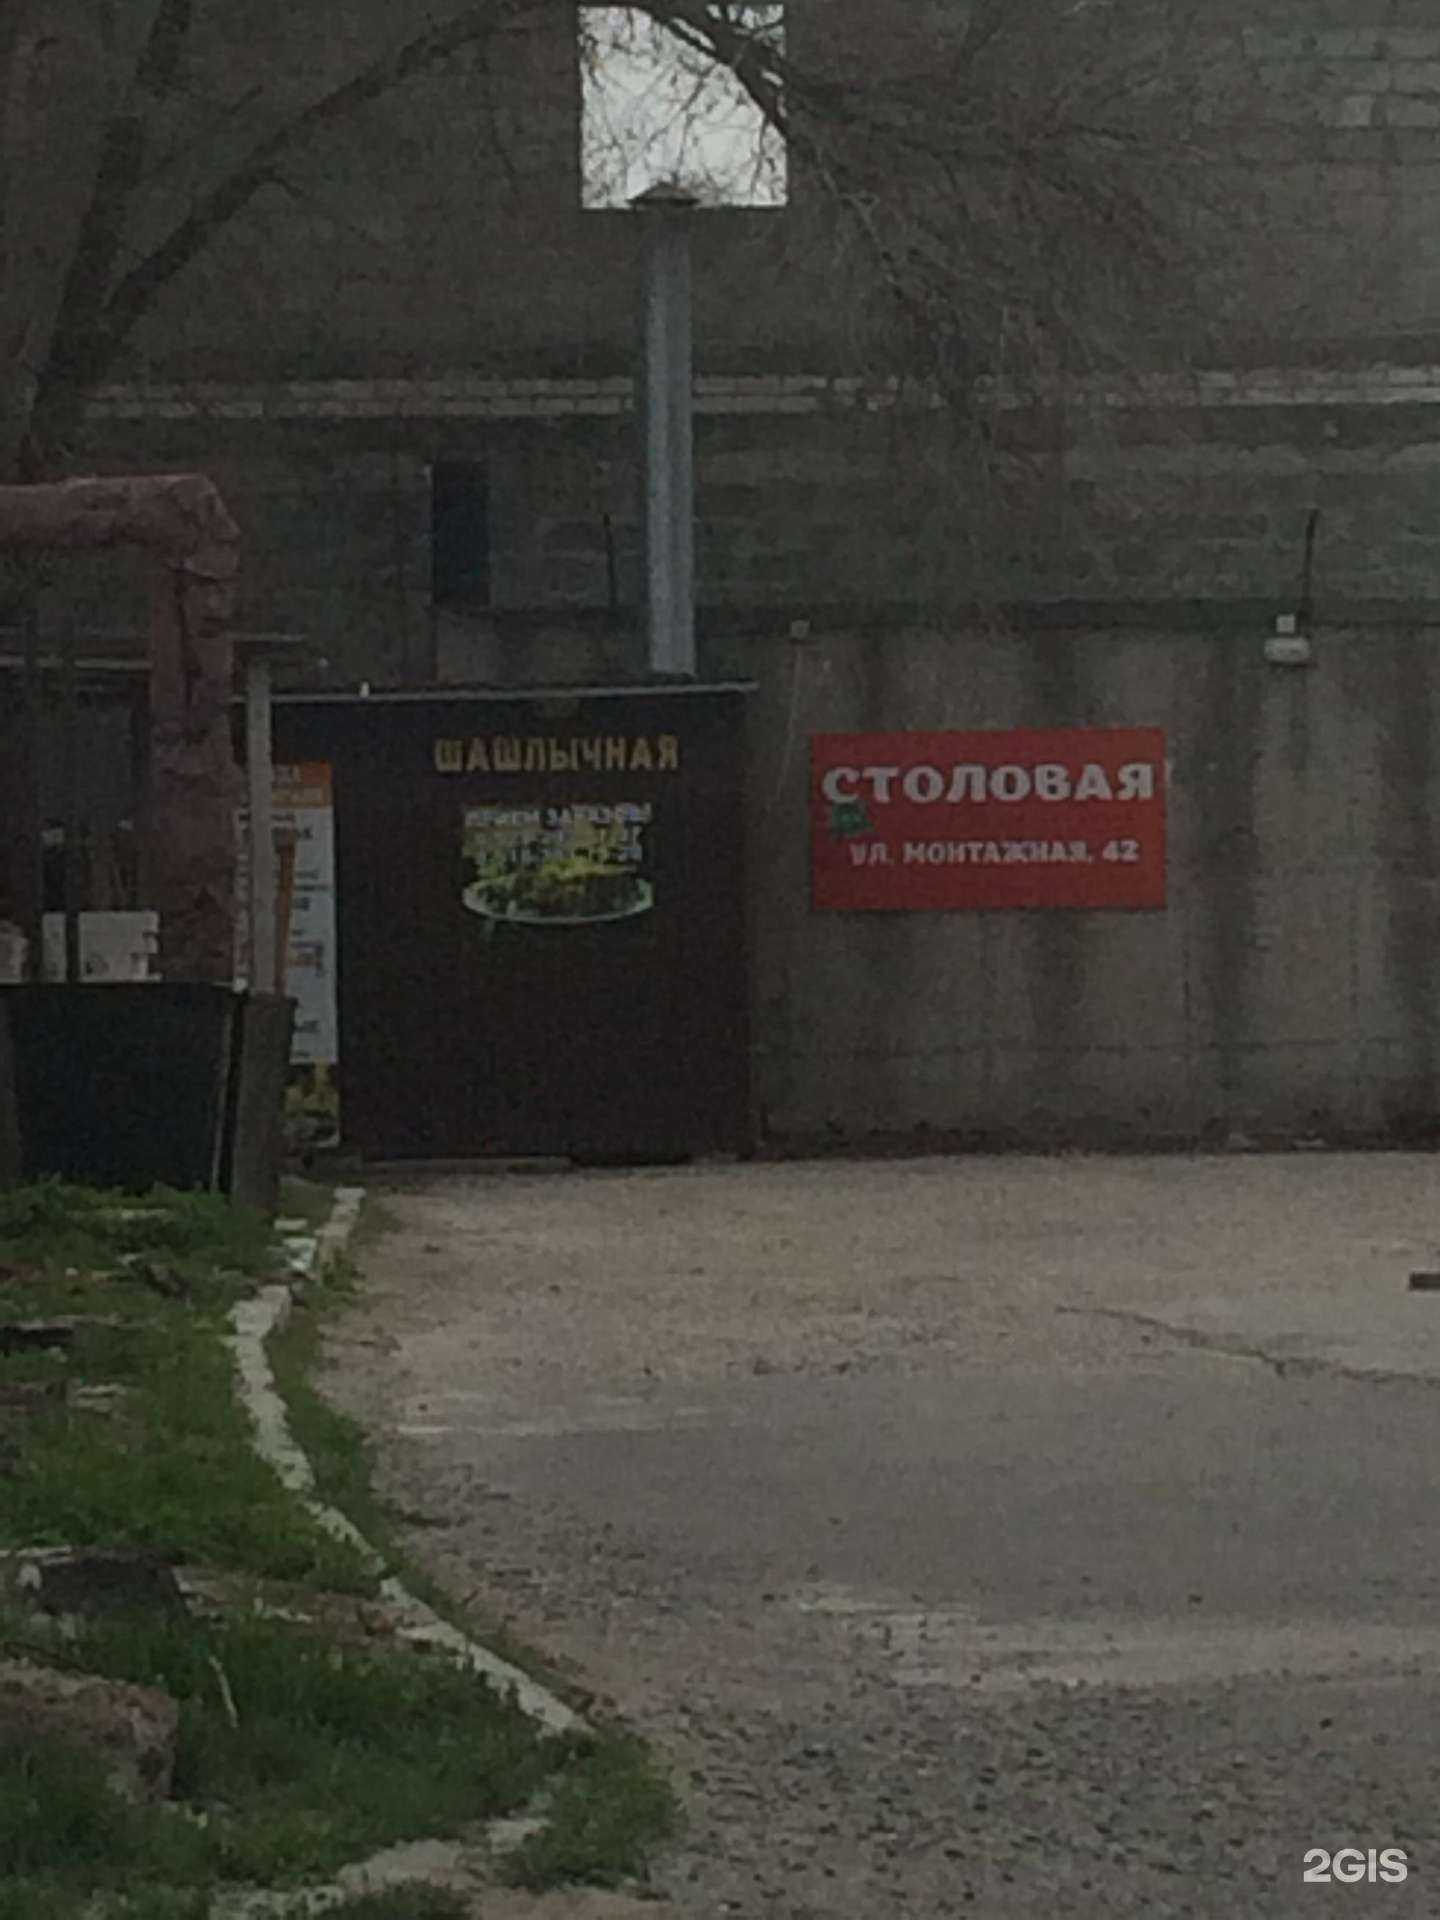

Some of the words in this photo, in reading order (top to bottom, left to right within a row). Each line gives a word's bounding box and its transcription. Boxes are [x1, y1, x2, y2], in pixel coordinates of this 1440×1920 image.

[435, 735, 679, 772] ШАШЛЫЧНАЯ
[822, 763, 1155, 803] СТОЛОВАЯ
[1102, 839, 1140, 862] 42
